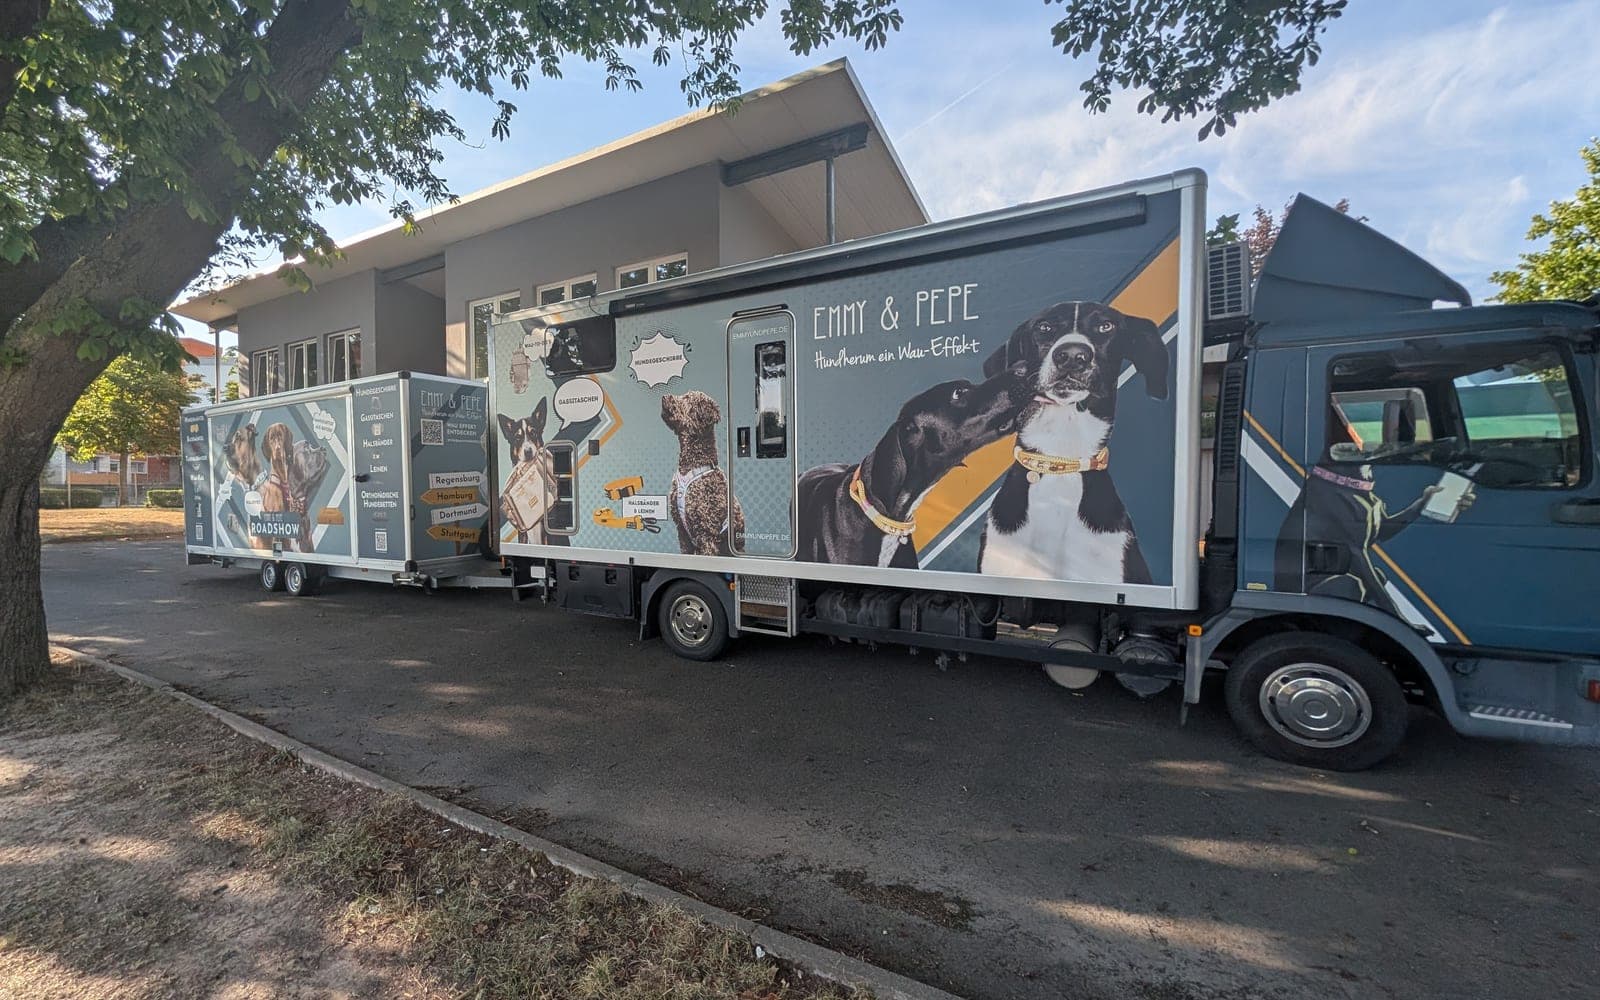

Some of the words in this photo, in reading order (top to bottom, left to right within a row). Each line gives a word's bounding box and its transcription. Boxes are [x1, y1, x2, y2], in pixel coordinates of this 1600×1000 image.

[814, 301, 867, 339] EMMY
[880, 296, 899, 331] &
[916, 283, 979, 326] PEPE
[814, 347, 876, 369] Hundherum
[878, 351, 896, 362] ein
[898, 334, 980, 360] Wau-Effekt
[421, 390, 444, 408] EMMY
[448, 393, 457, 409] &
[461, 394, 481, 412] PEPE
[559, 396, 599, 405] GASSITASCHEN
[435, 474, 480, 486] Regensburg
[439, 505, 478, 520] Dortmund
[250, 521, 300, 536] ROADSHOW
[440, 527, 476, 540] Stuttgart
